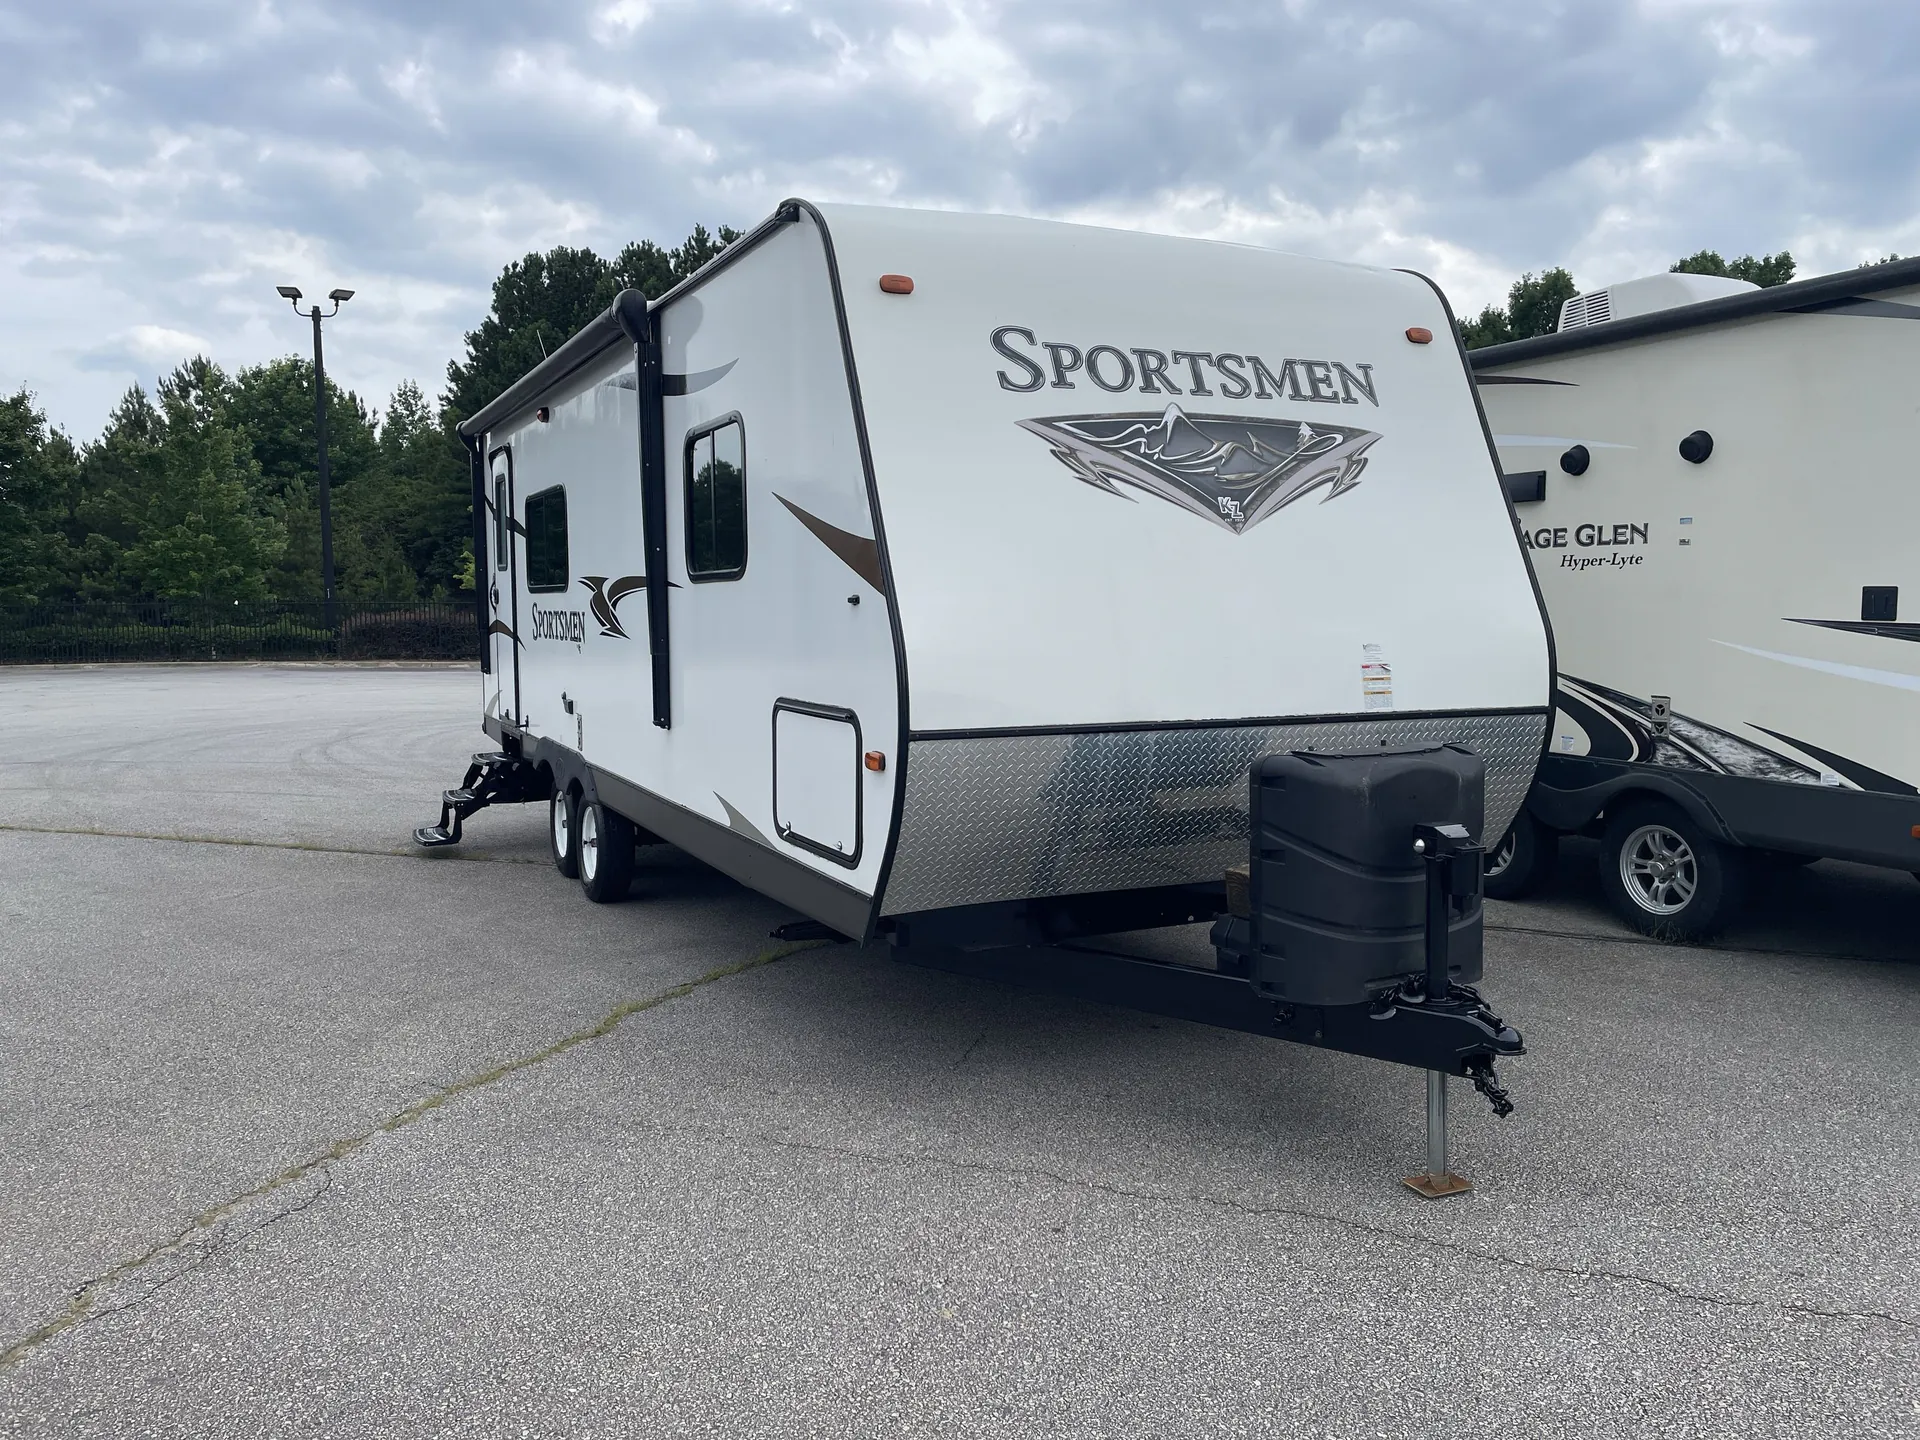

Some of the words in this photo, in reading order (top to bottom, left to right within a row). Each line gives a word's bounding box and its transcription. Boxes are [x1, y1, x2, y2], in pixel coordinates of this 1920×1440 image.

[990, 325, 1379, 407] SPORTSMEN
[1575, 523, 1649, 547] GLEN
[1560, 552, 1643, 571] Hyper-Lyte
[532, 602, 585, 644] SPORTSMEN
